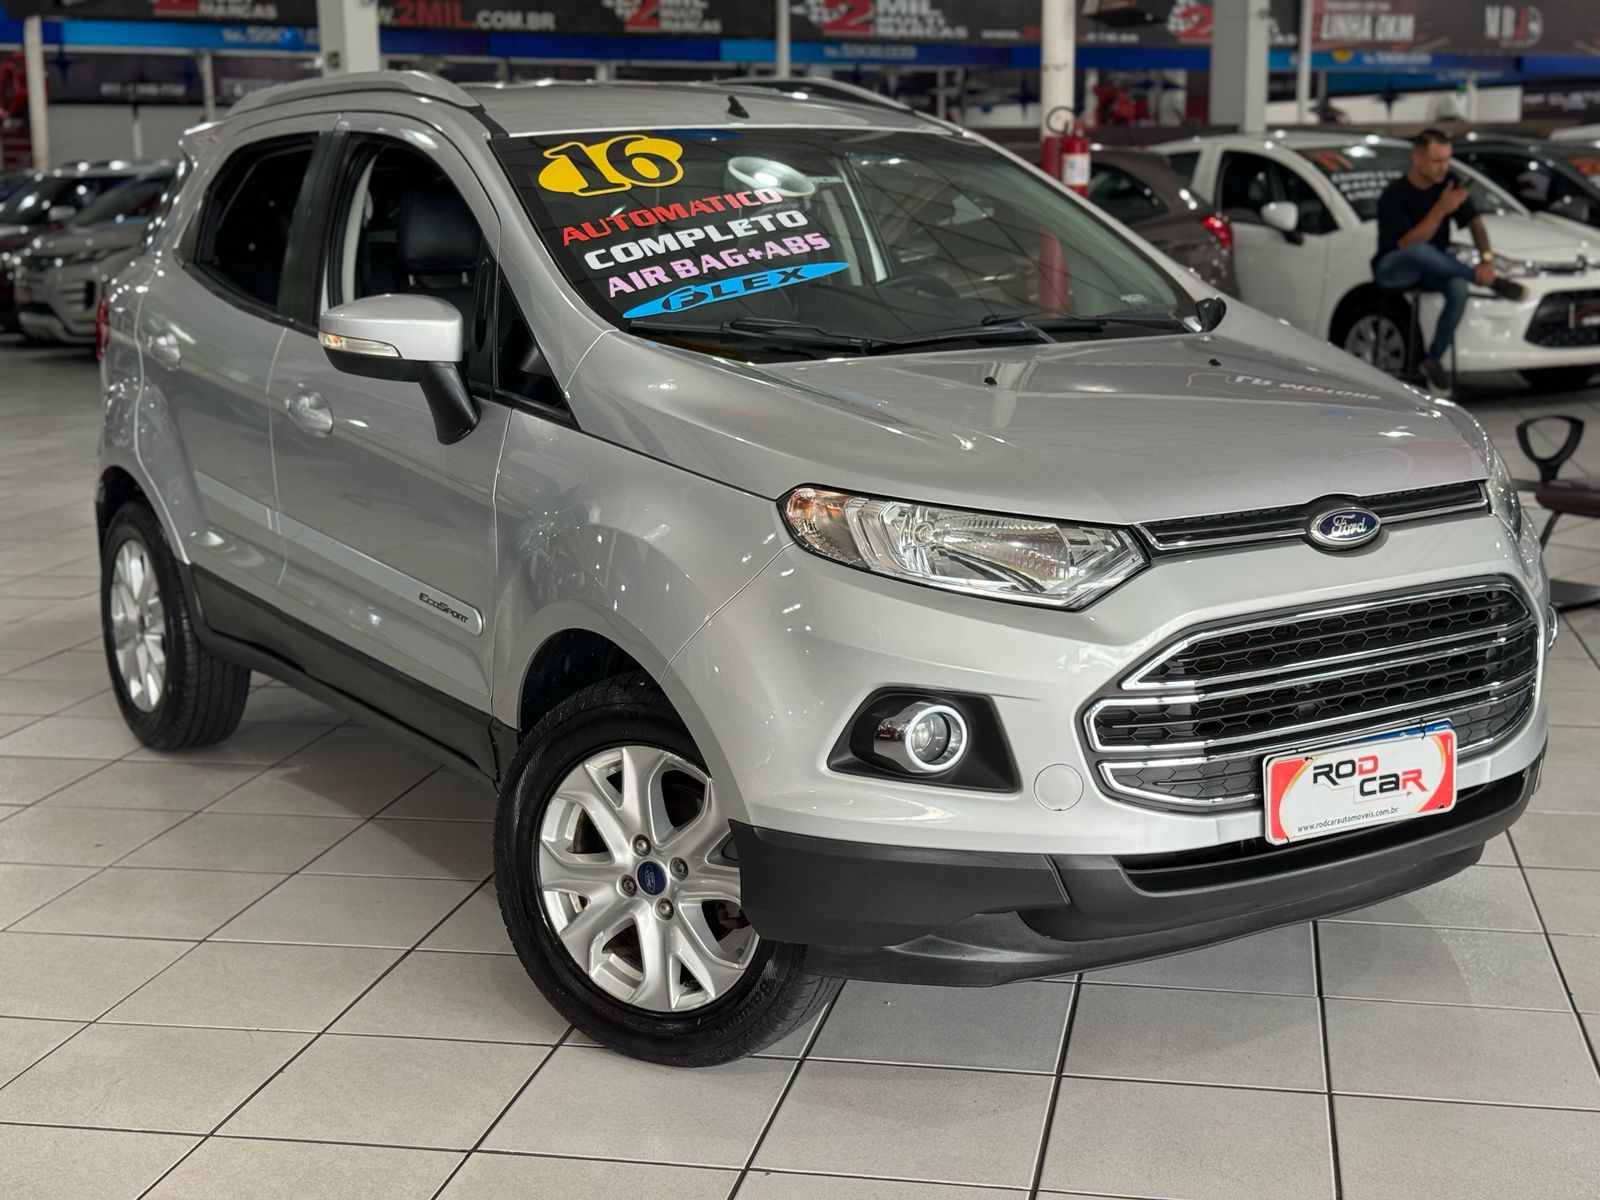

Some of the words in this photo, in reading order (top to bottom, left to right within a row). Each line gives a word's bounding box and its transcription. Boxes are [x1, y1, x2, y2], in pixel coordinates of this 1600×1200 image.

[543, 135, 684, 196] 16
[563, 188, 784, 247] AUTOMATICO
[584, 210, 809, 271] COMPLETO
[608, 265, 673, 298] AIR
[669, 232, 832, 280] BAG+ABS
[662, 265, 805, 312] FLEX
[1325, 513, 1368, 538] Ford
[1312, 754, 1380, 786] ROD
[1297, 806, 1399, 833] www.rodcarautomoveis.com.br
